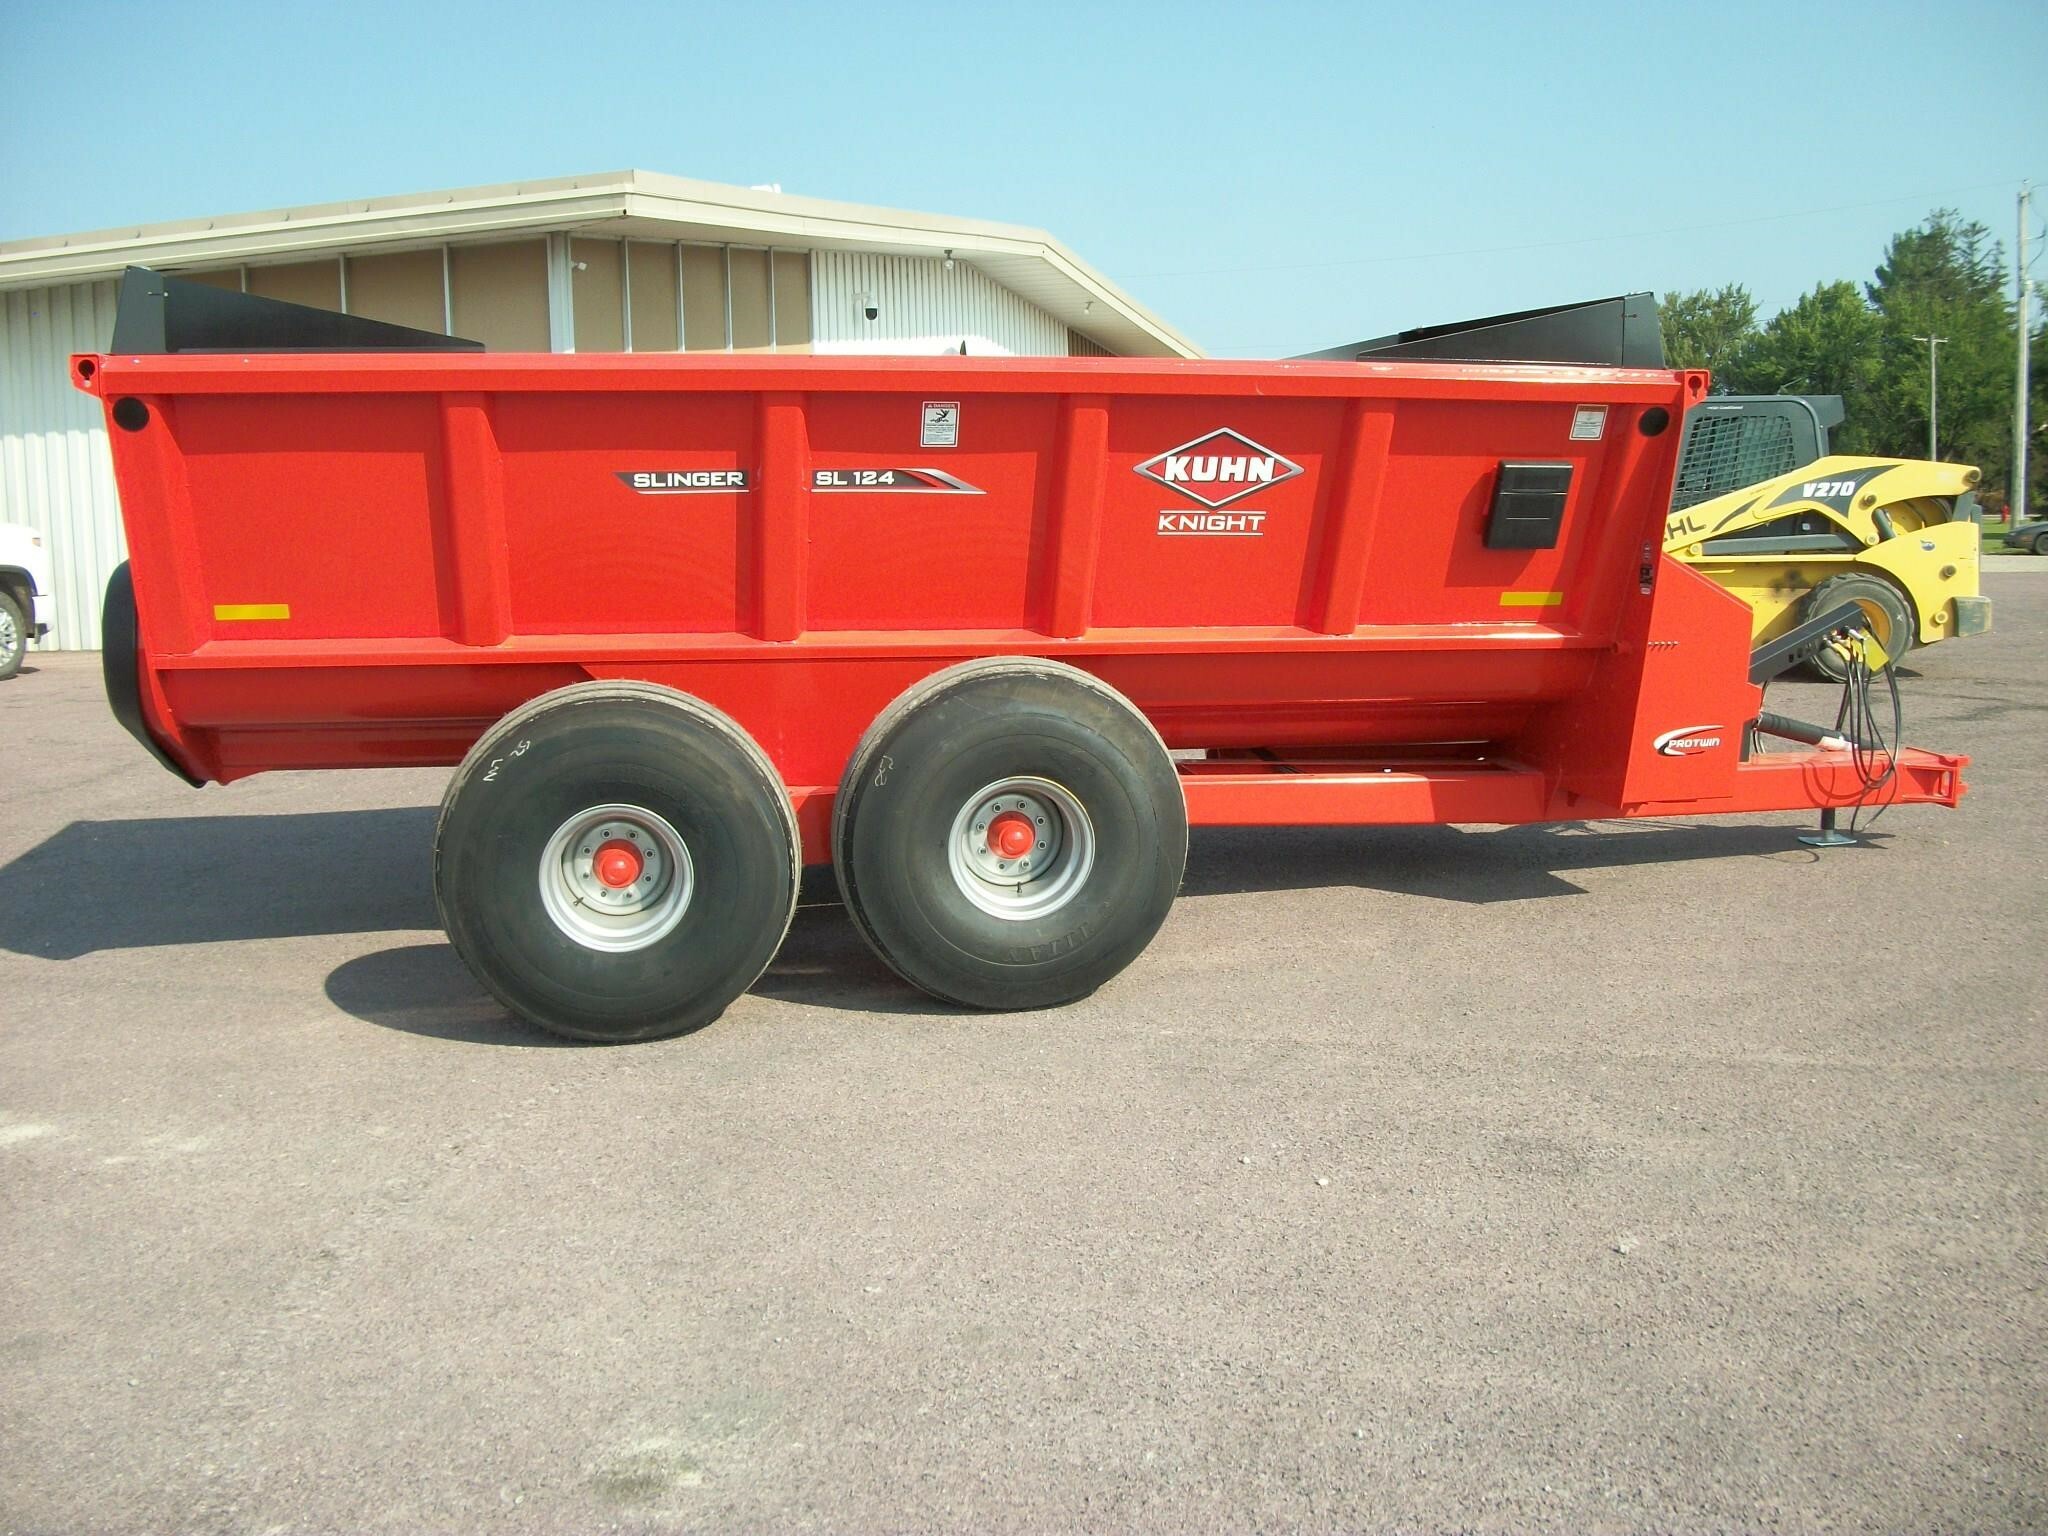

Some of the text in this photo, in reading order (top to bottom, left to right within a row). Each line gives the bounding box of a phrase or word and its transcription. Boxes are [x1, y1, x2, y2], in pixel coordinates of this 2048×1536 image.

[1164, 456, 1275, 482] KUHN
[633, 471, 745, 488] SLINGER
[816, 471, 896, 486] SL 124
[1802, 481, 1856, 498] V270
[1158, 514, 1266, 531] KNIGHT
[1664, 515, 1706, 542] HL
